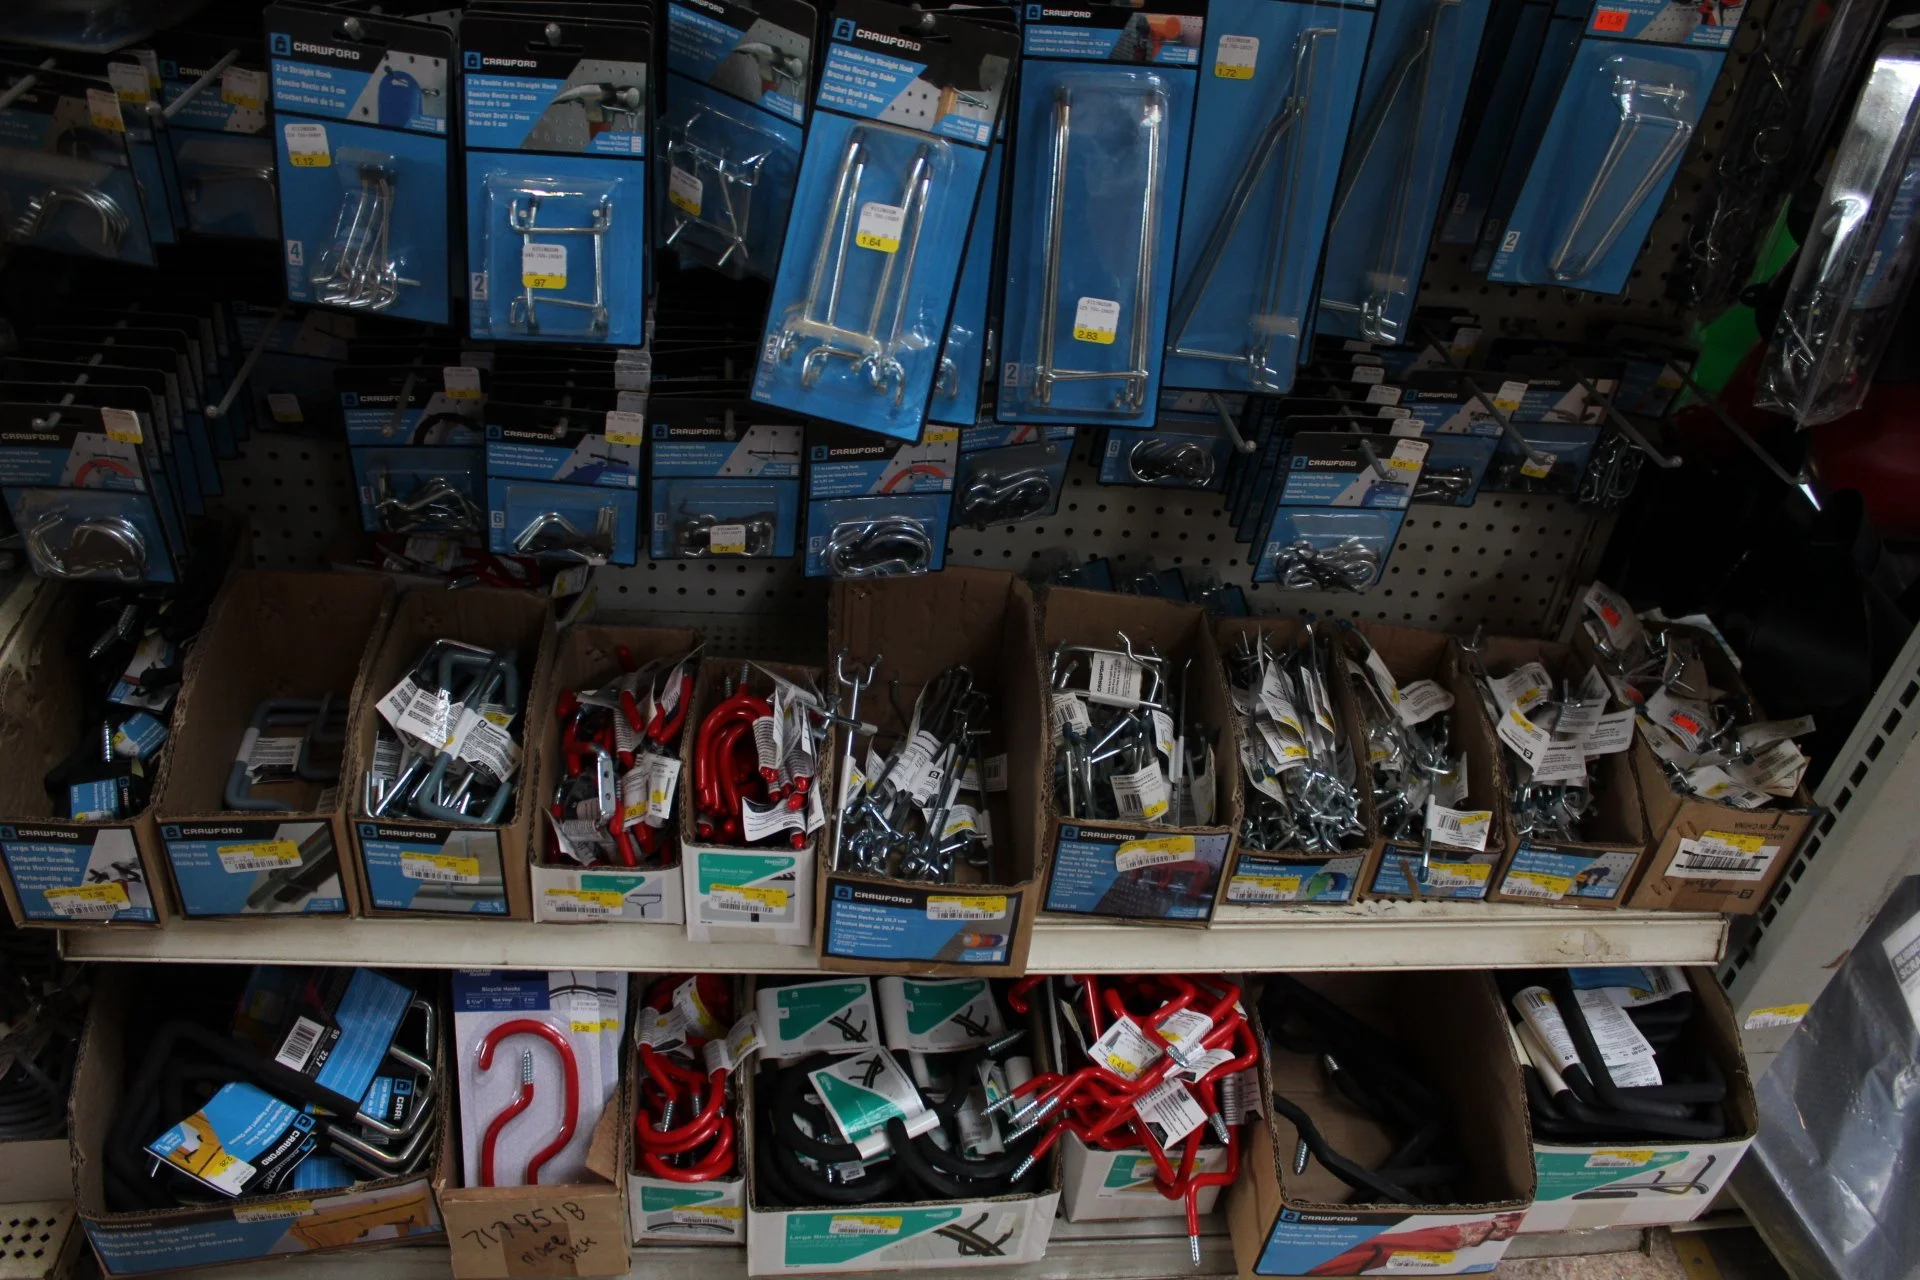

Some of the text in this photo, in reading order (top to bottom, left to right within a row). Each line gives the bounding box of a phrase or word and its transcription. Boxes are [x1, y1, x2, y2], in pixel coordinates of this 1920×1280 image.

[1042, 9, 1092, 18] CRAWFORD
[856, 28, 922, 52] CRAWFORD
[293, 42, 361, 60] CRAWFORD
[482, 57, 537, 68] CRAWFORD
[862, 236, 881, 247] 1.64
[1506, 232, 1517, 246] 2
[290, 245, 299, 255] 4
[474, 277, 484, 292] 2
[1077, 330, 1099, 341] 2.83
[1007, 364, 1016, 380] 2
[1, 432, 60, 441] CRAWFORD
[503, 430, 557, 441] CRAWFORD
[829, 446, 885, 456] CRAWFORD
[1308, 459, 1357, 467] CRAWFORD
[494, 512, 502, 523] 6
[17, 829, 79, 839] CRAWFORD
[182, 827, 243, 835] CRAWFORD
[378, 829, 437, 839] CRAWFORD
[1080, 830, 1136, 841] CRAWFORD
[6, 845, 29, 853] Large
[48, 846, 76, 854] Hanger
[854, 891, 913, 905] CRAWFORD
[330, 1028, 341, 1040] 50
[316, 1049, 329, 1068] 22.7
[1112, 1058, 1125, 1069] 1.41
[261, 1129, 301, 1167] CRAWFORD
[219, 1155, 233, 1168] 2.28
